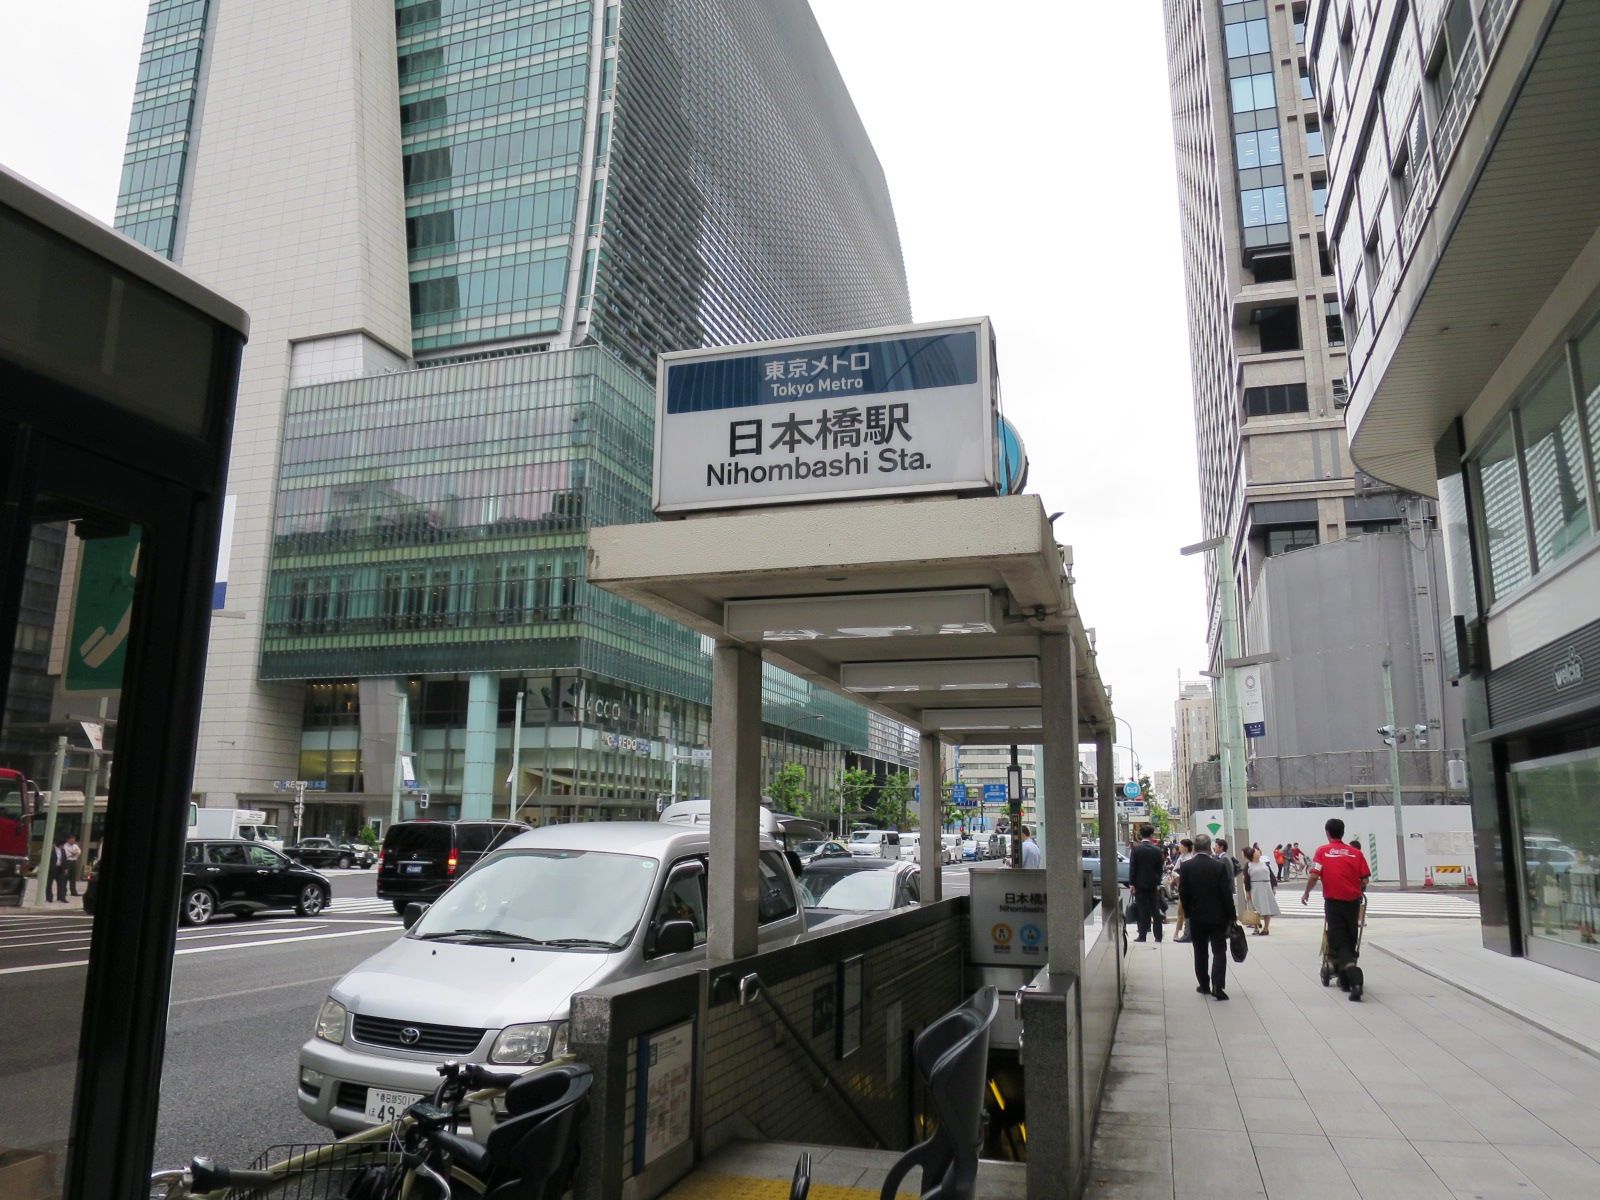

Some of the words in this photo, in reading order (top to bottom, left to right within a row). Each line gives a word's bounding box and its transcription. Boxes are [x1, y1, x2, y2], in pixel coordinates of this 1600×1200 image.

[764, 352, 871, 381] 東京メトロ
[770, 380, 815, 399] Tokyo
[818, 377, 864, 392] Metro
[729, 402, 913, 458] 日本橋駅
[706, 450, 870, 487] Nihombashi
[878, 447, 932, 473] Sta.
[1005, 893, 1047, 905] 日本橋
